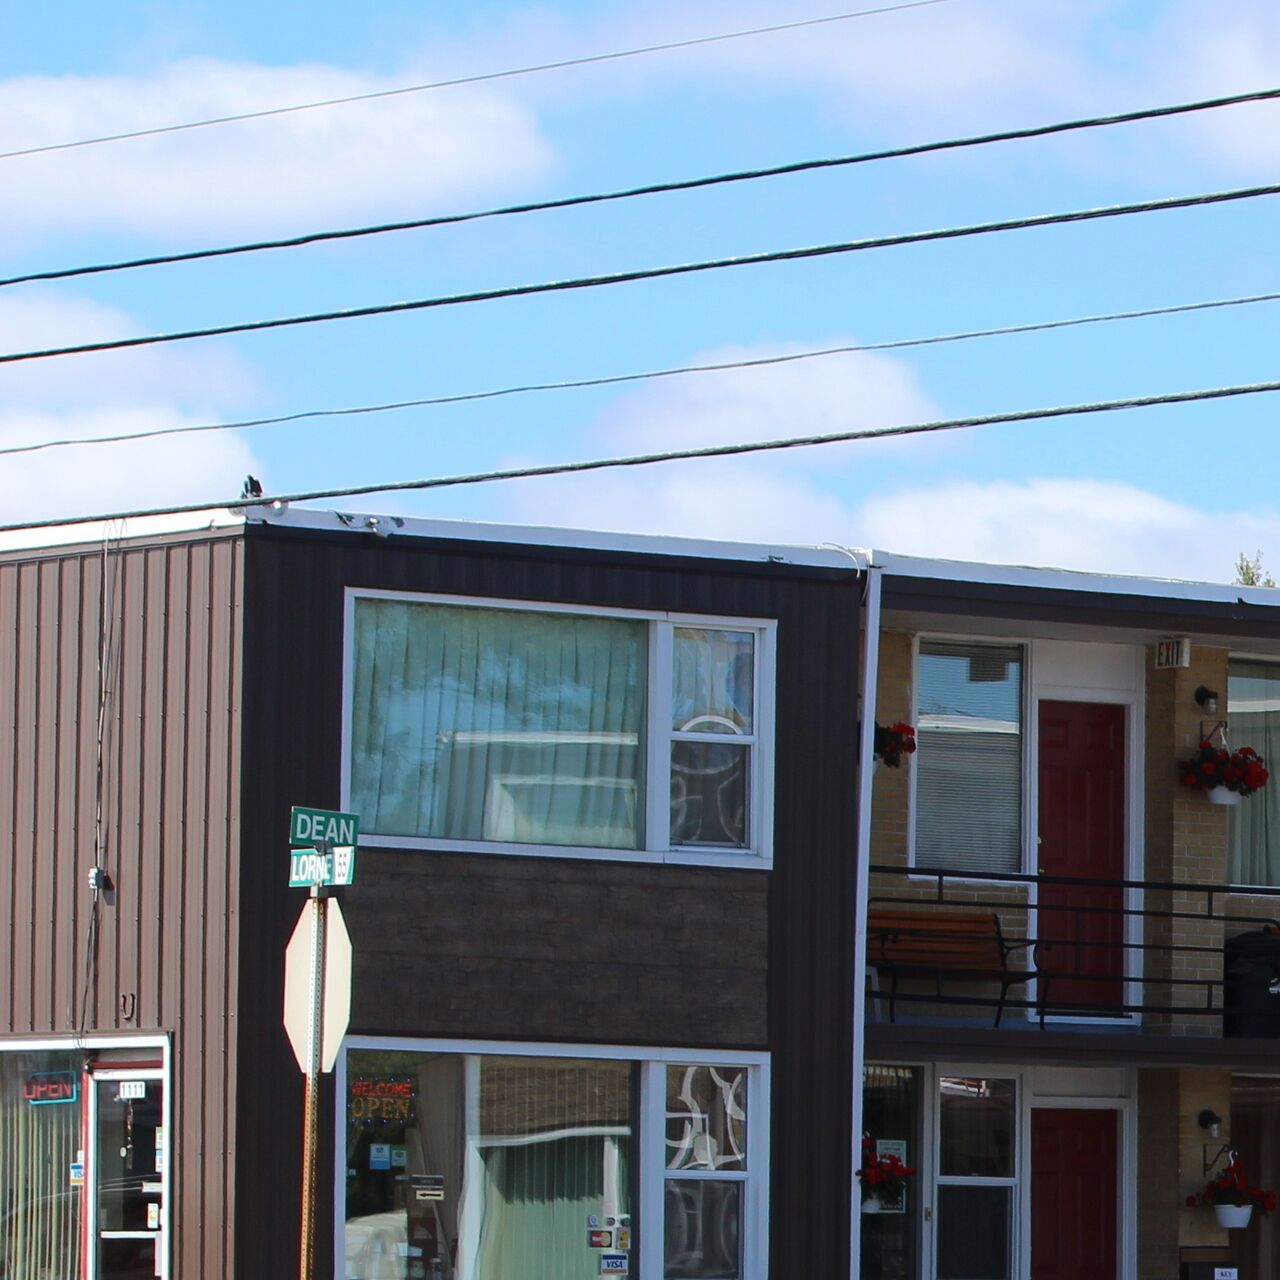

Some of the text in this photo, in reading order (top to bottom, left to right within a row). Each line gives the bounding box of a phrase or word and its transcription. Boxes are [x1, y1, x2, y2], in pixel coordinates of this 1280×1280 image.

[1158, 641, 1181, 666] EXIT
[296, 813, 354, 844] DEAN
[291, 852, 333, 881] LORNE
[23, 1079, 72, 1099] OPEN
[121, 1083, 144, 1097] 1111
[352, 1081, 412, 1098] WELCOME
[352, 1097, 409, 1119] OPEN
[606, 1260, 623, 1269] VISA
